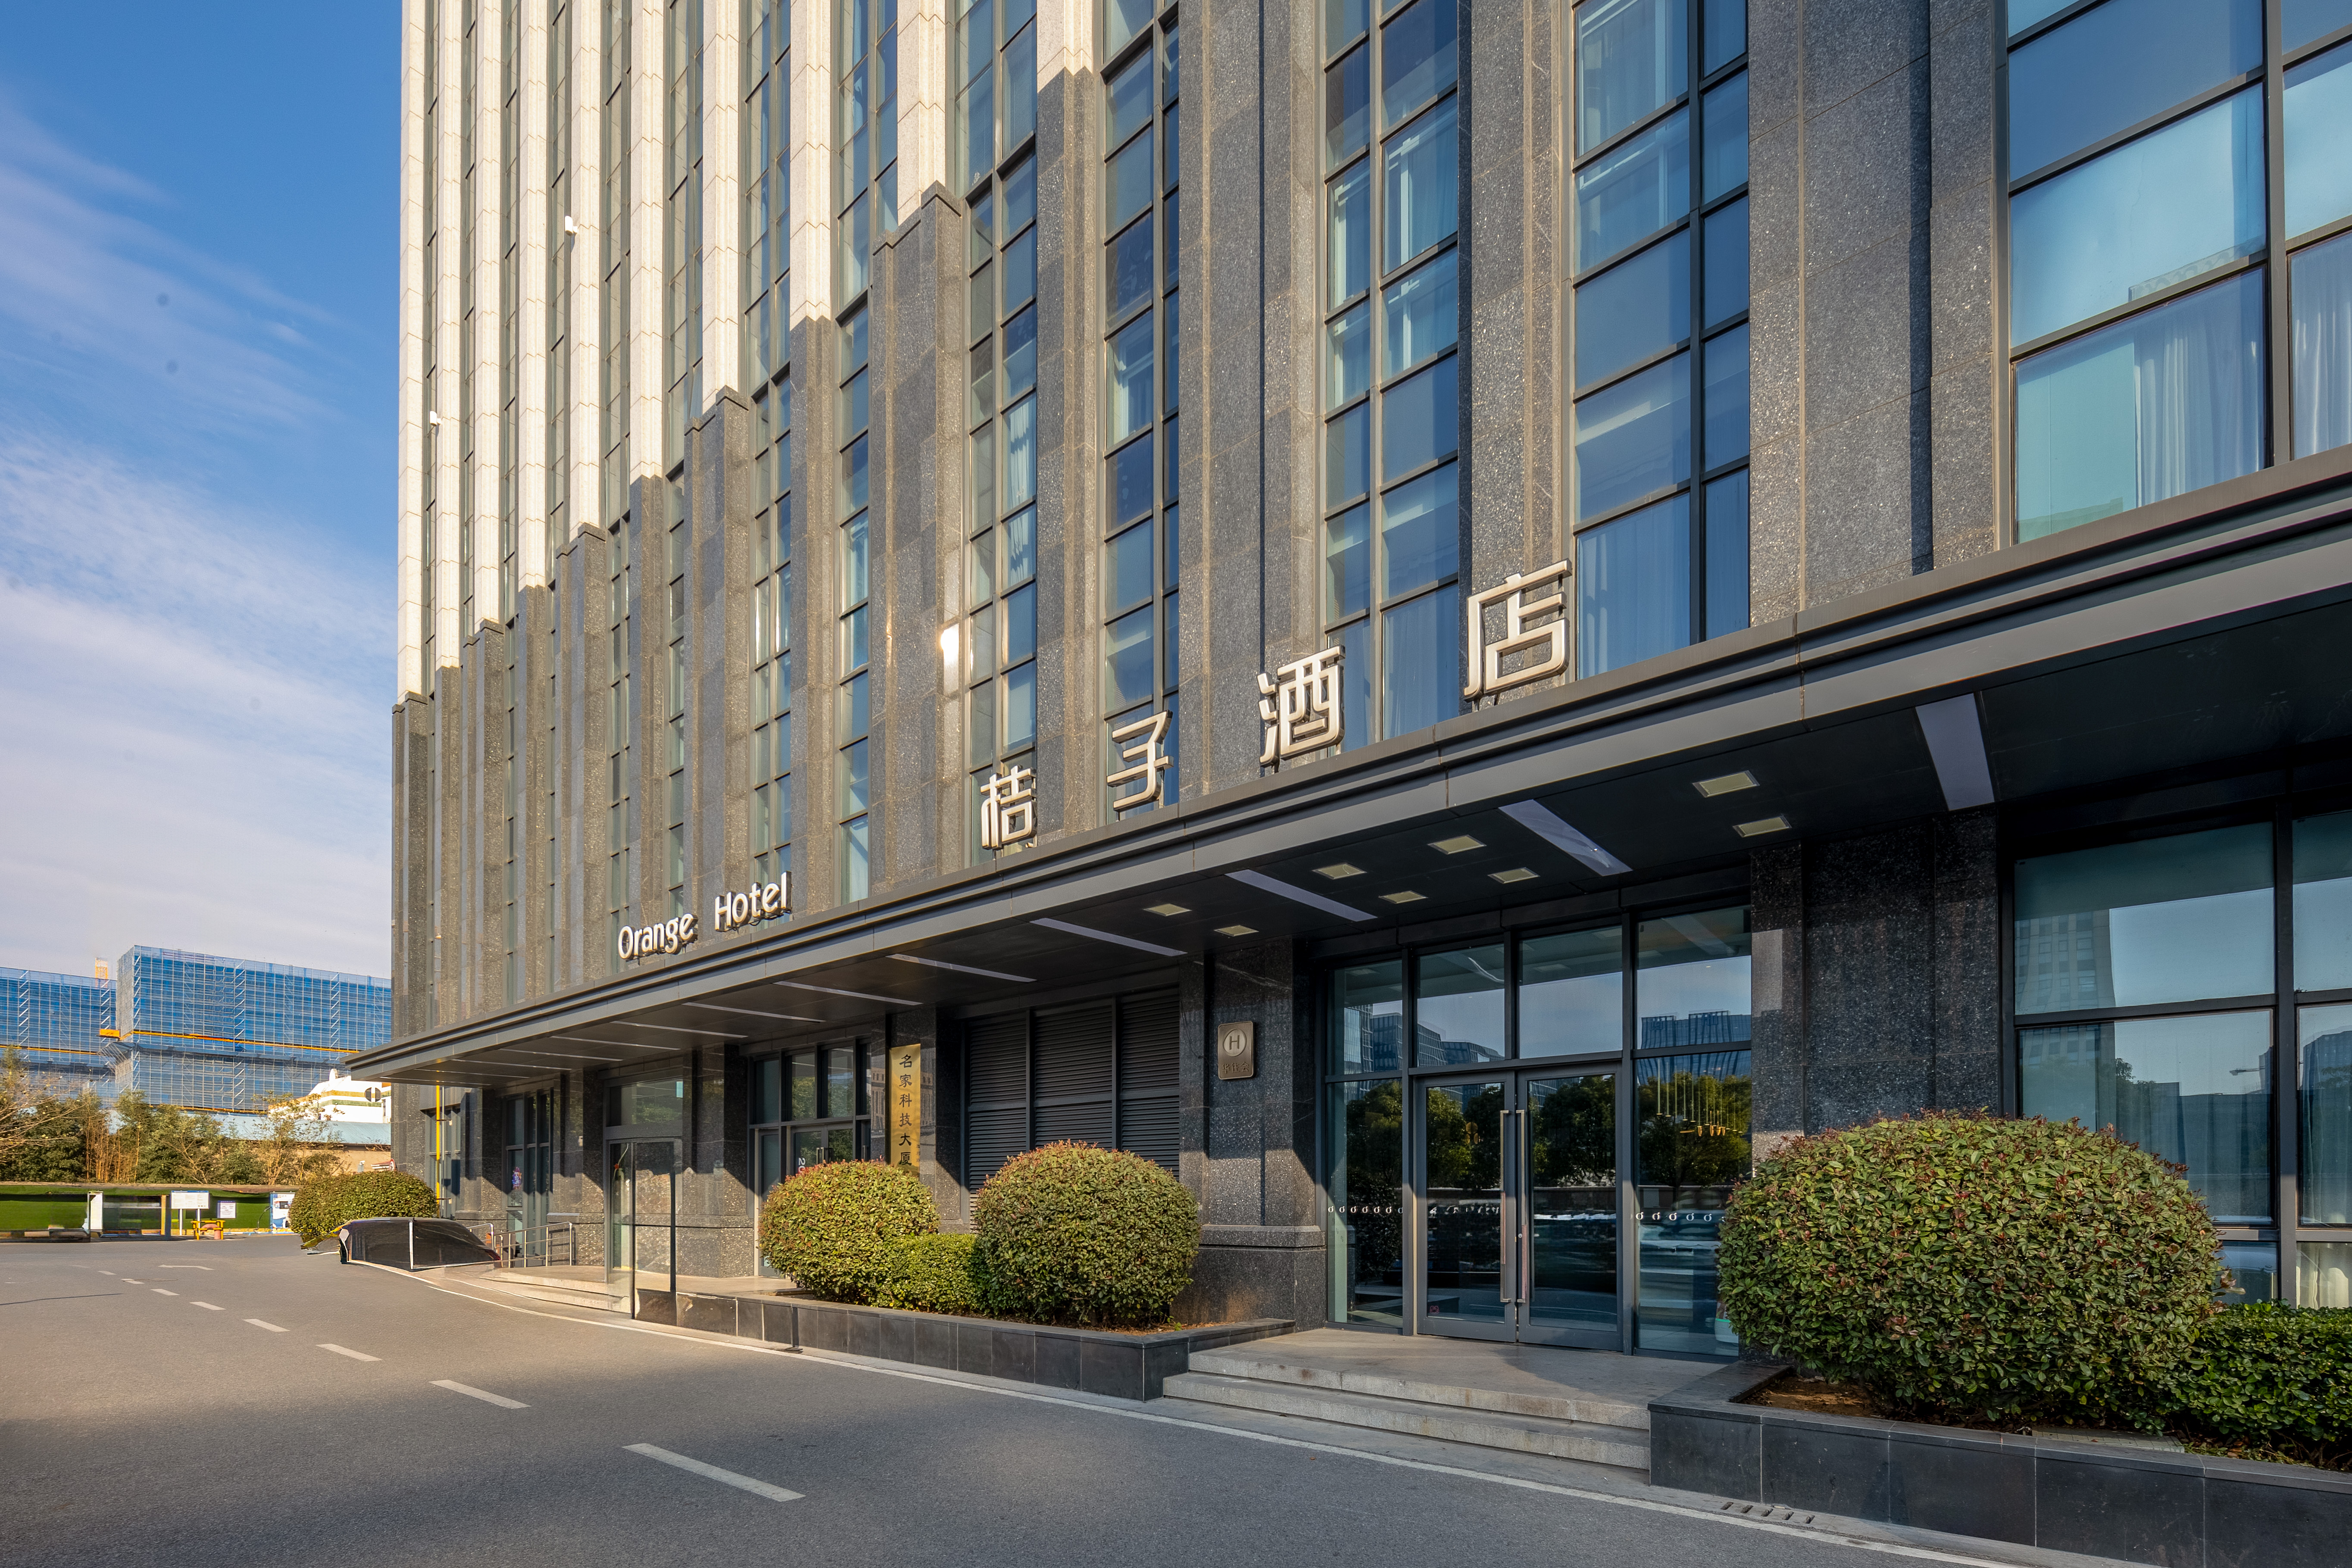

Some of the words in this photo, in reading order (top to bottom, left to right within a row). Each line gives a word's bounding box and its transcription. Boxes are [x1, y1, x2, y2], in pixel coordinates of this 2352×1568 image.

[980, 559, 1573, 850] 桔子酒店
[618, 913, 698, 959] Orange
[715, 871, 791, 932] Hotel
[899, 1054, 912, 1165] 名家科技大厦
[1222, 1062, 1249, 1074] 华住会
